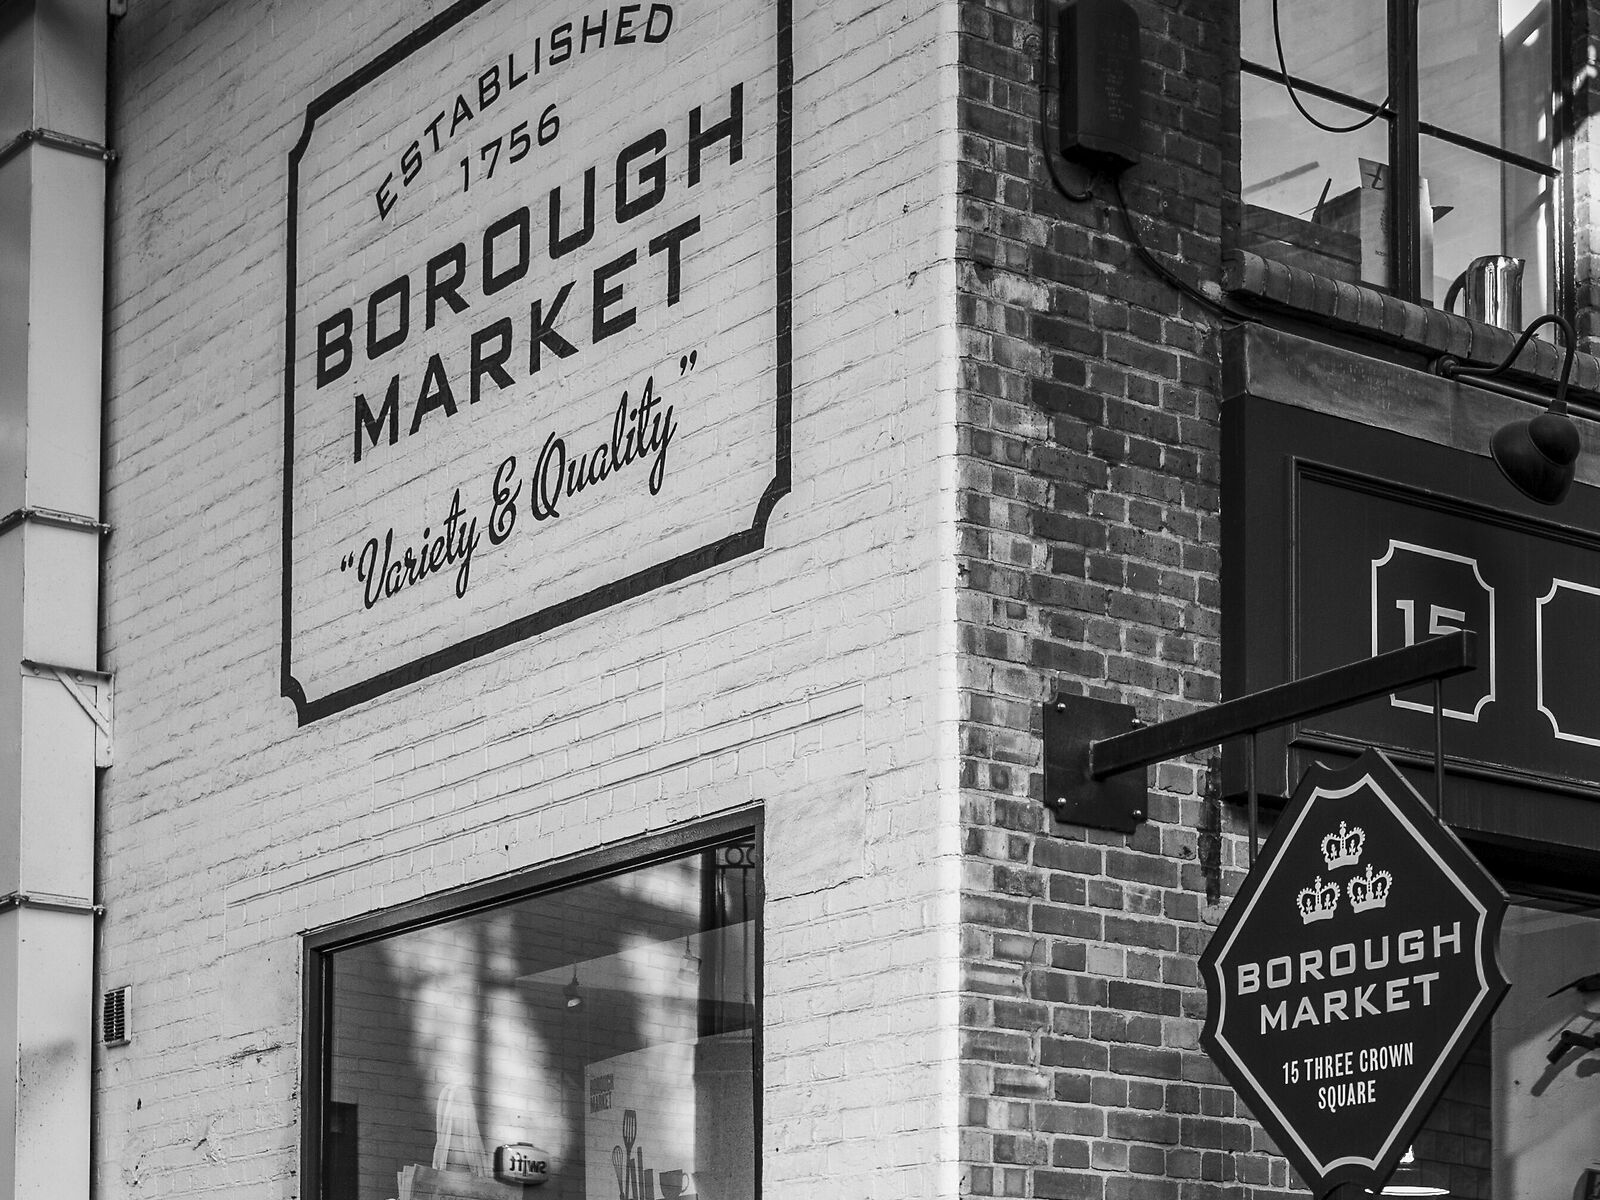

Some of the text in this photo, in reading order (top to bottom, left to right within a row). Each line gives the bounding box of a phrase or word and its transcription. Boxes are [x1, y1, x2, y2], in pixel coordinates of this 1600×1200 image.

[375, 3, 673, 221] ESTABLISHED
[459, 102, 561, 192] 1756
[316, 82, 744, 390] BOROUGH
[353, 215, 701, 464] MARKET
[487, 455, 522, 546] &
[1237, 921, 1461, 996] BOROUGH
[1260, 971, 1440, 1035] MARKET
[1282, 1042, 1414, 1085] 15 THREE CROWN
[1318, 1080, 1376, 1113] SQUARE
